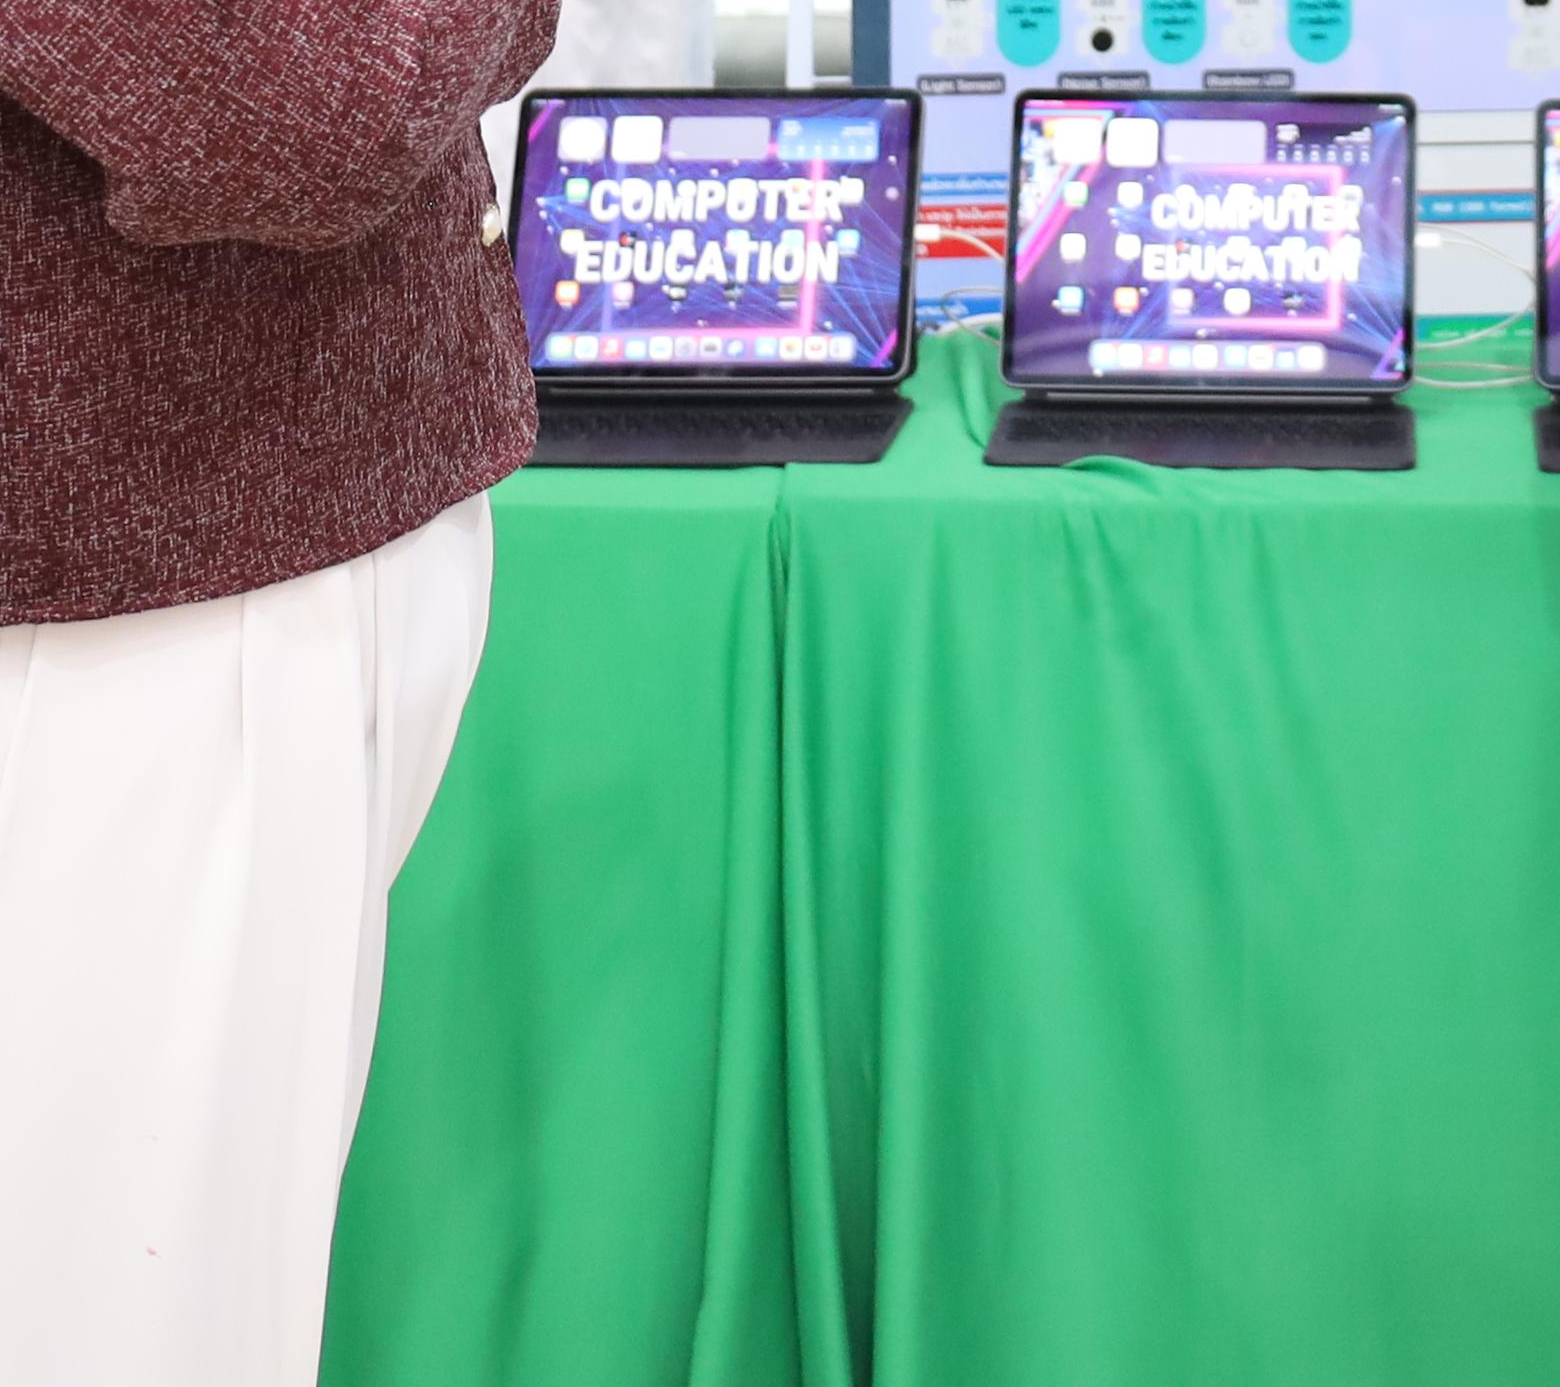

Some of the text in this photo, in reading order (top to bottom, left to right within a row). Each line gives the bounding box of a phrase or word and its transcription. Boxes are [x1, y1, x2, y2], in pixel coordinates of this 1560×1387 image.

[590, 179, 844, 223] COMPUTER
[1150, 193, 1361, 232] COMPUTER
[574, 239, 840, 284] EDUCATION
[1142, 243, 1360, 282] EDUCATION
